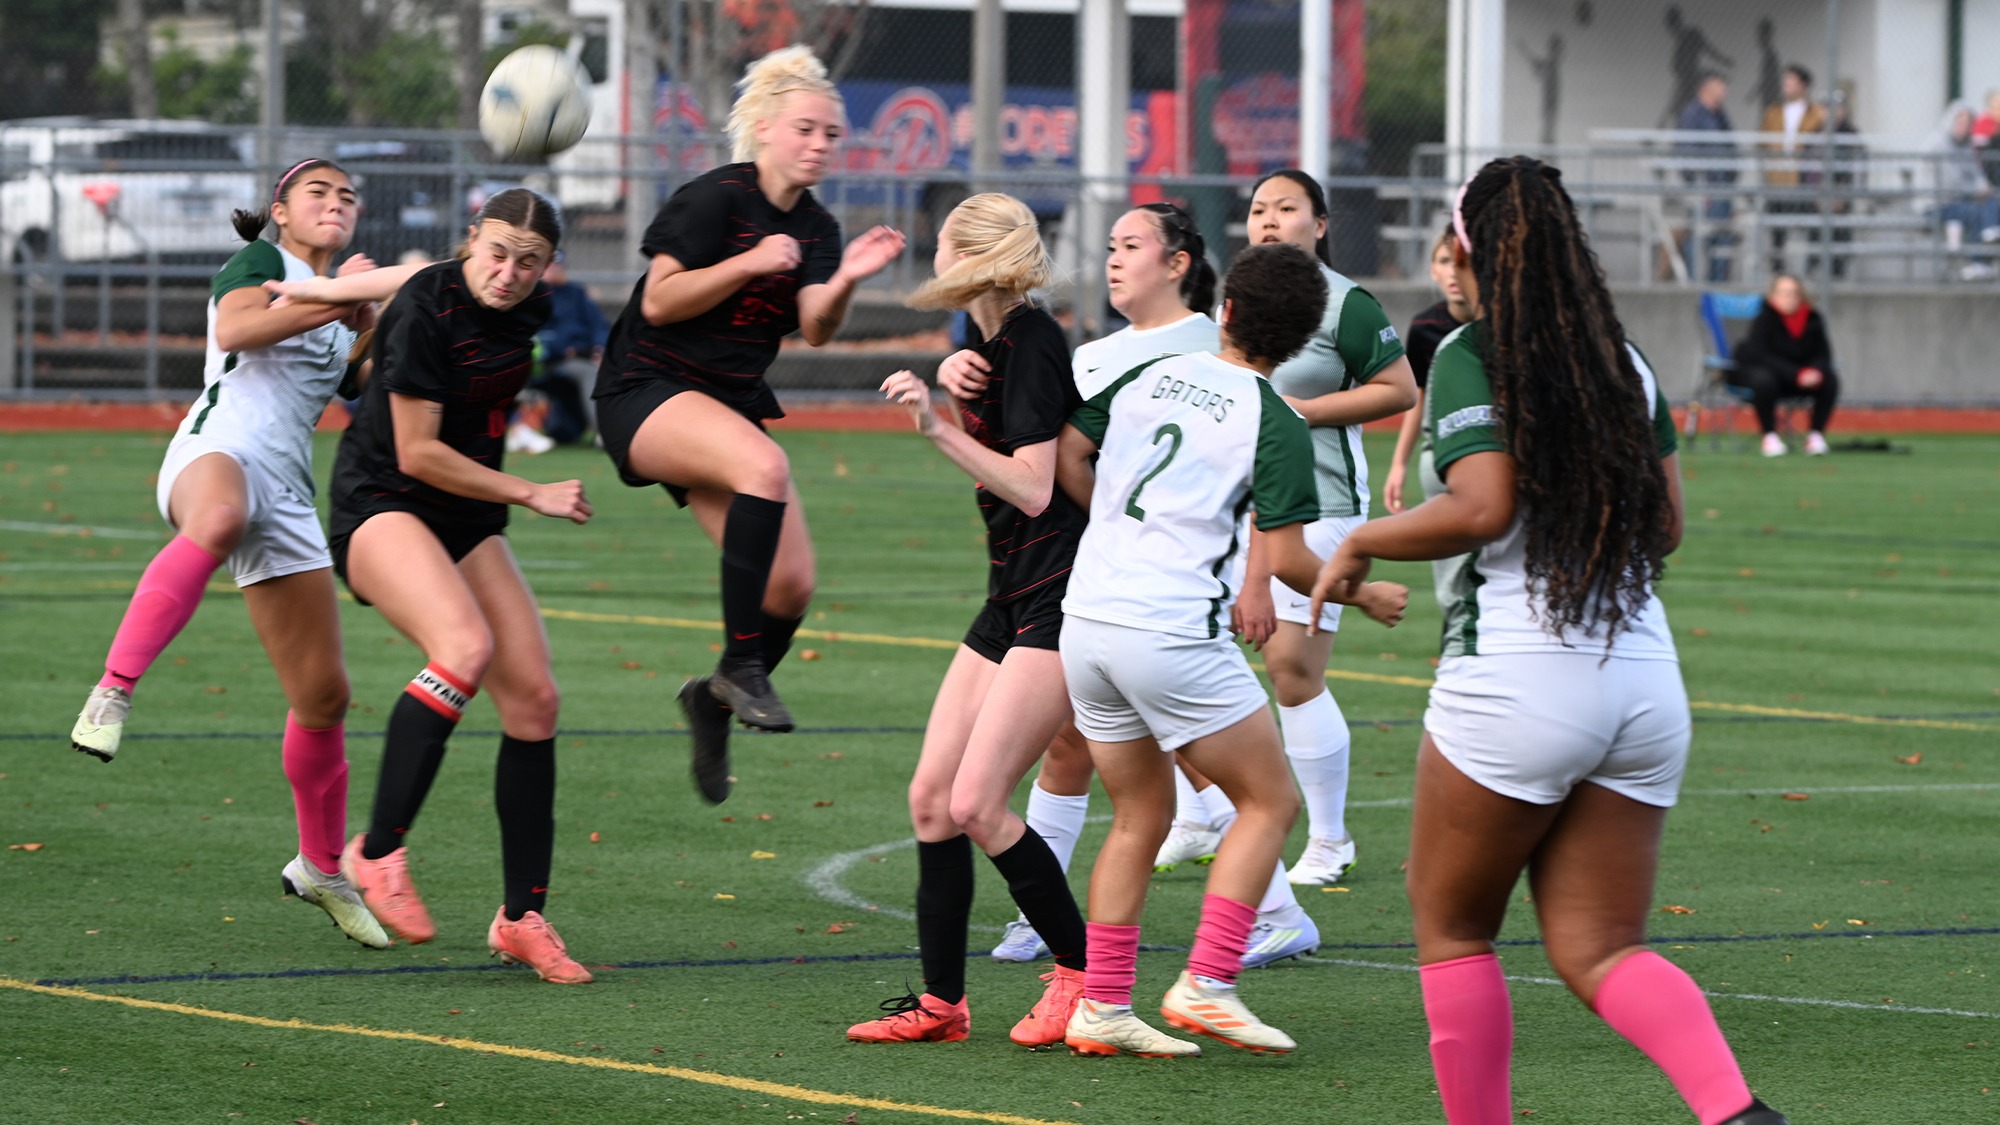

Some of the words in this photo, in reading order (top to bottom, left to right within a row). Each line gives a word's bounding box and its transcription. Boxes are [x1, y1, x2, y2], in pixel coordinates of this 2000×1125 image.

[1151, 375, 1234, 423] GATORS
[1125, 423, 1182, 523] 2
[417, 672, 468, 709] APTAIN
